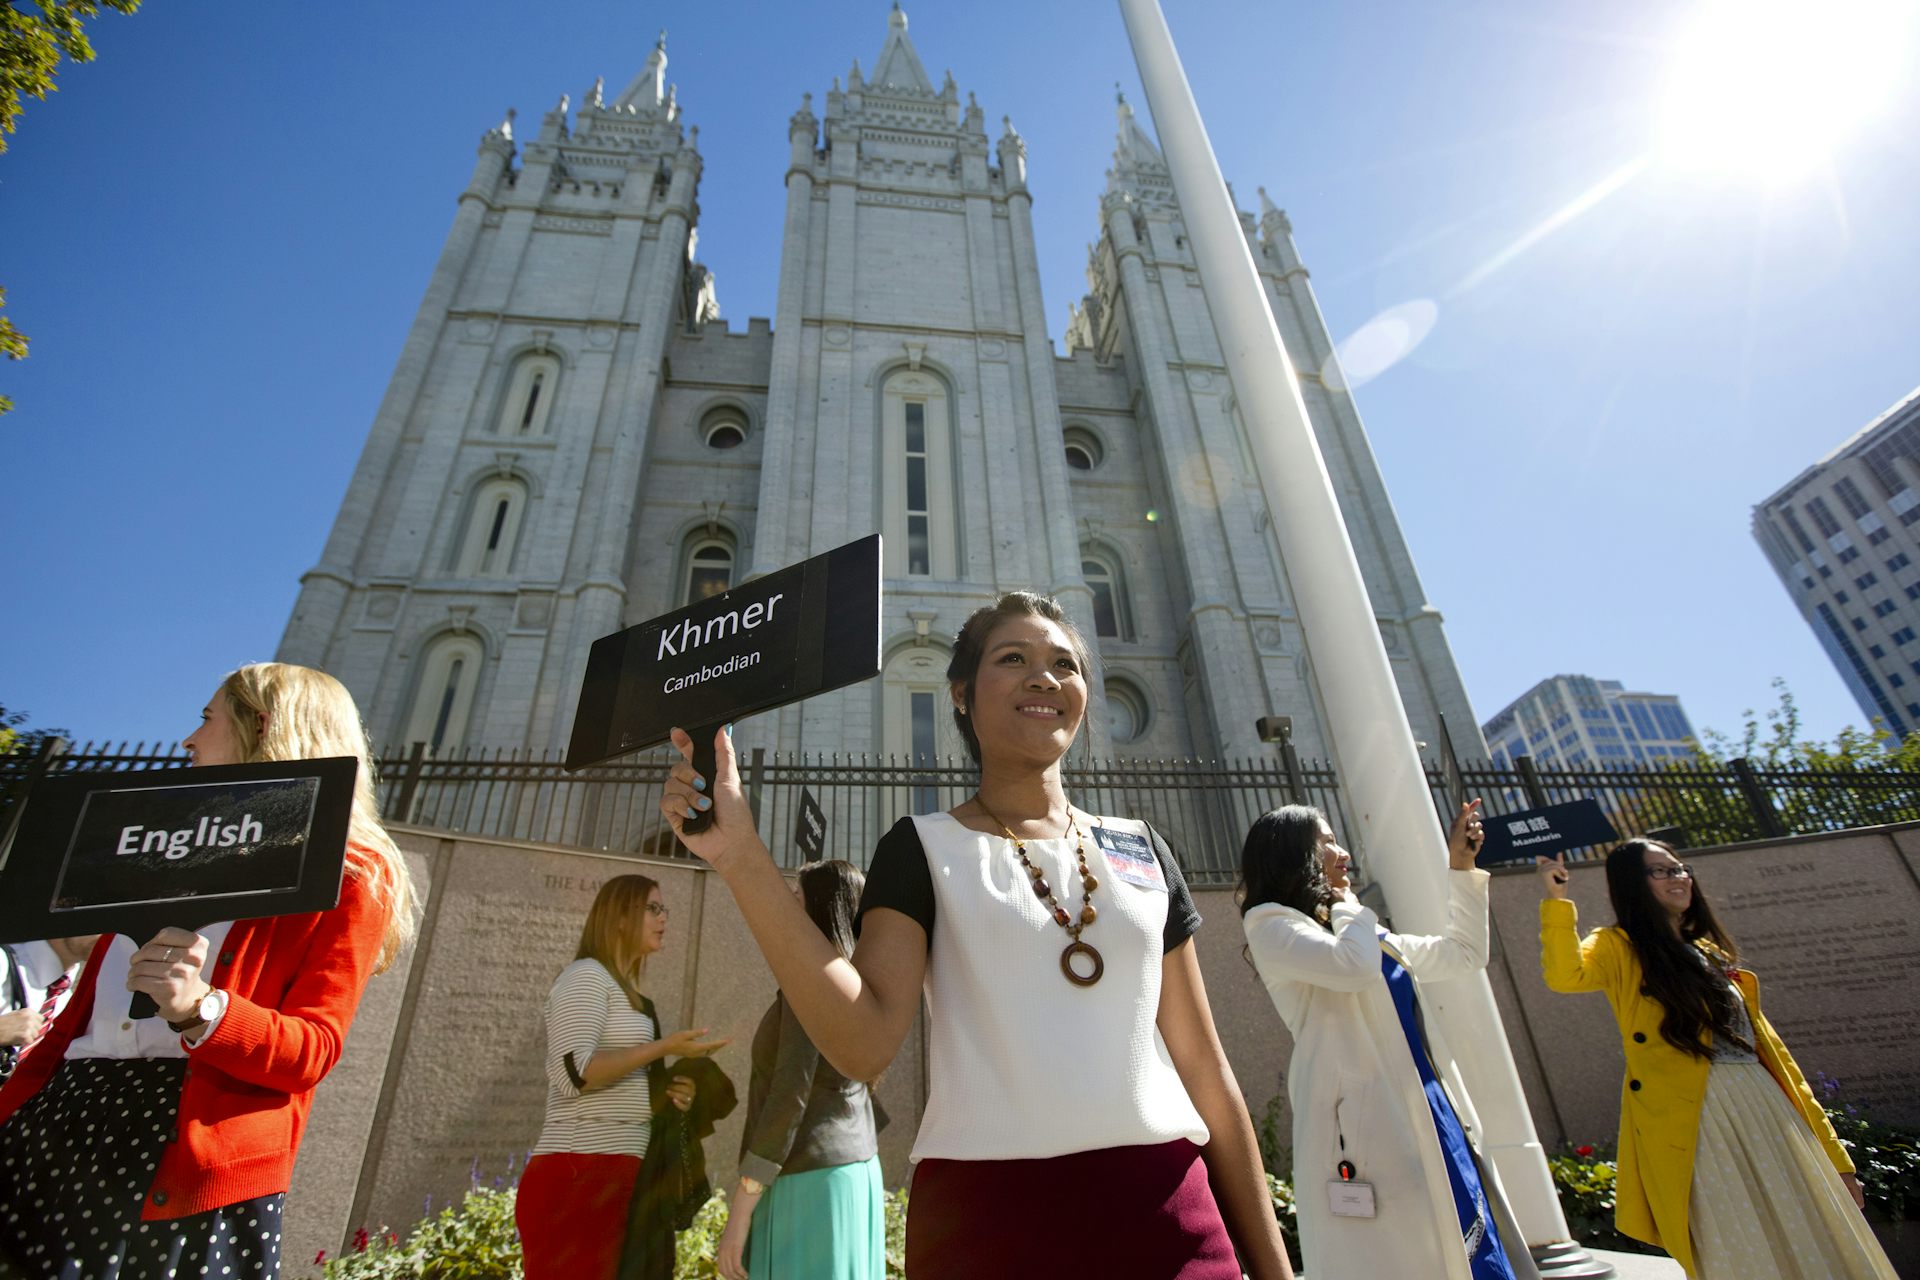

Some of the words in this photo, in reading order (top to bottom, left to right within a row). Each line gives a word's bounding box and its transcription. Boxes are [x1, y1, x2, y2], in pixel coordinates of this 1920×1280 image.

[656, 593, 783, 661] Khmer
[664, 651, 761, 693] Cambodian
[116, 814, 263, 860] English
[1512, 833, 1561, 847] Mandarin
[545, 875, 573, 889] THE
[579, 879, 602, 891] LA
[1757, 866, 1785, 878] THE
